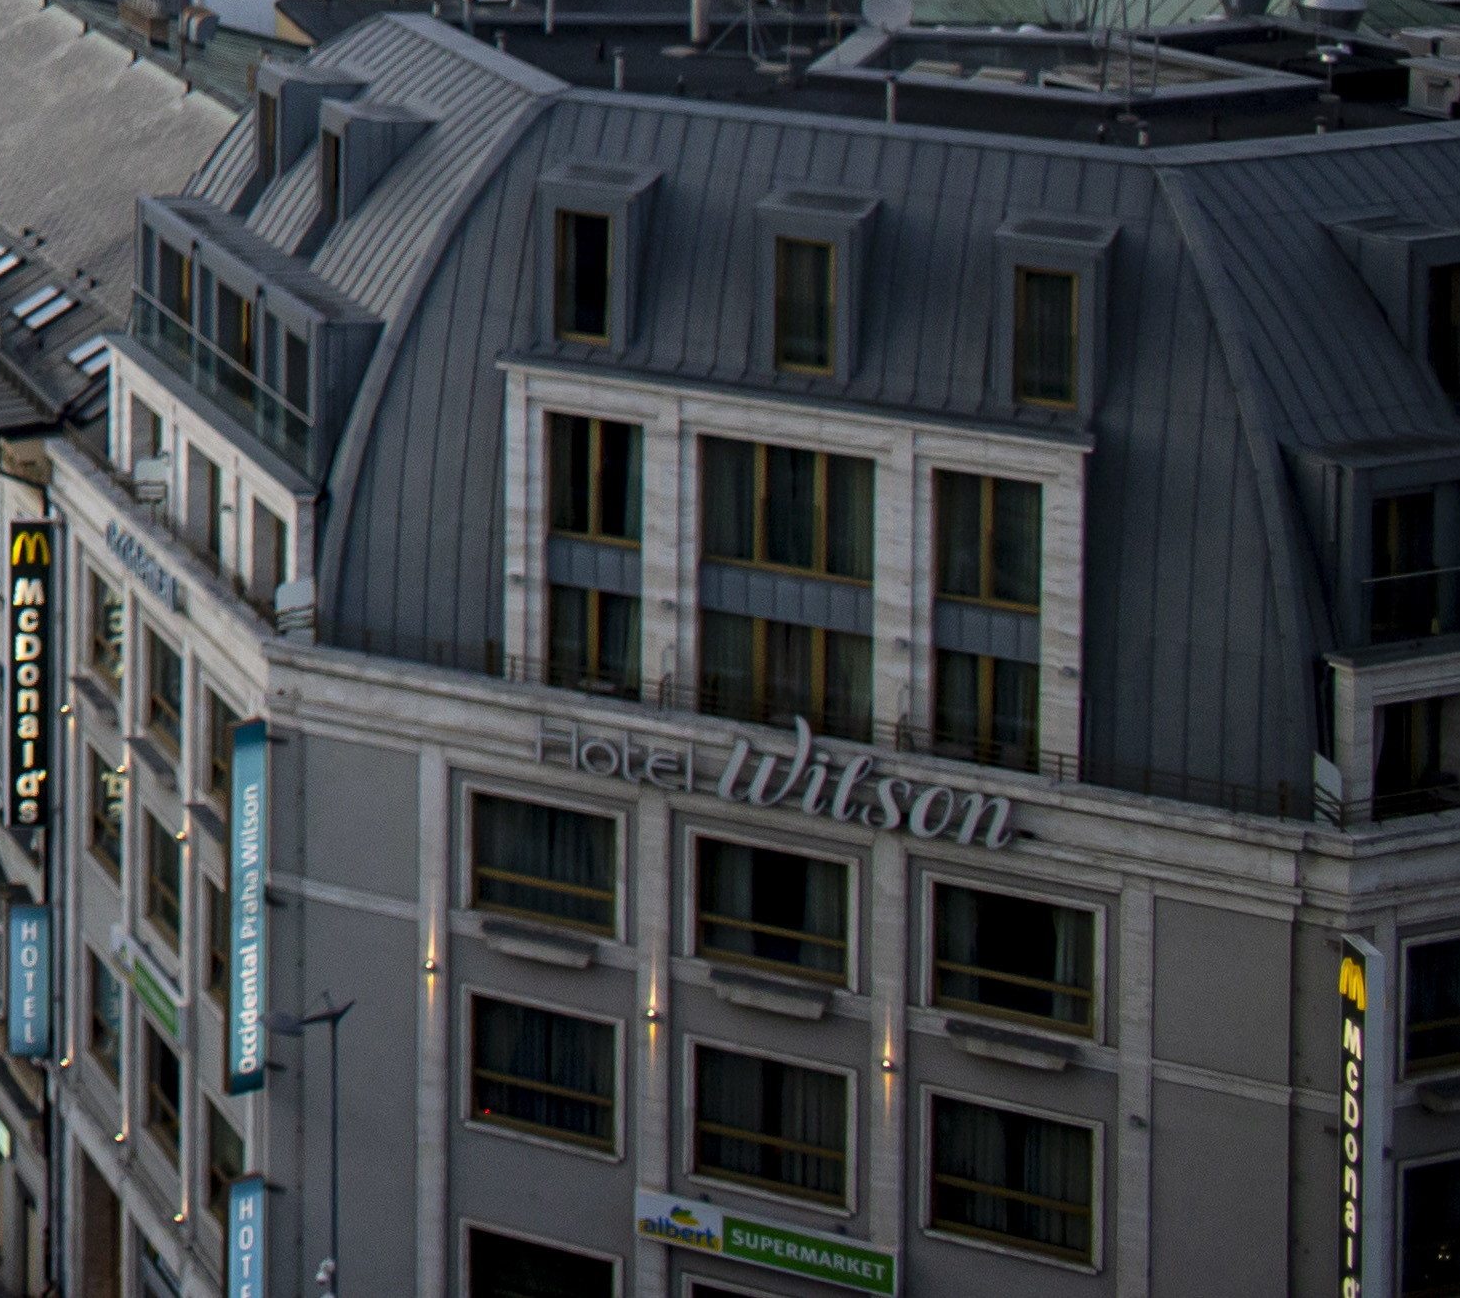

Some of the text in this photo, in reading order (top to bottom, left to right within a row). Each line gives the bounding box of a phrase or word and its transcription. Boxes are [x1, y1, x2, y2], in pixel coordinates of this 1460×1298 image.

[12, 577, 47, 824] McDonald's
[534, 714, 1014, 850] Hotel Wilson
[20, 920, 39, 1045] HOTEL
[239, 783, 259, 1075] Occidental Praha Wilson
[639, 1215, 887, 1281] albert SUPERMARKET
